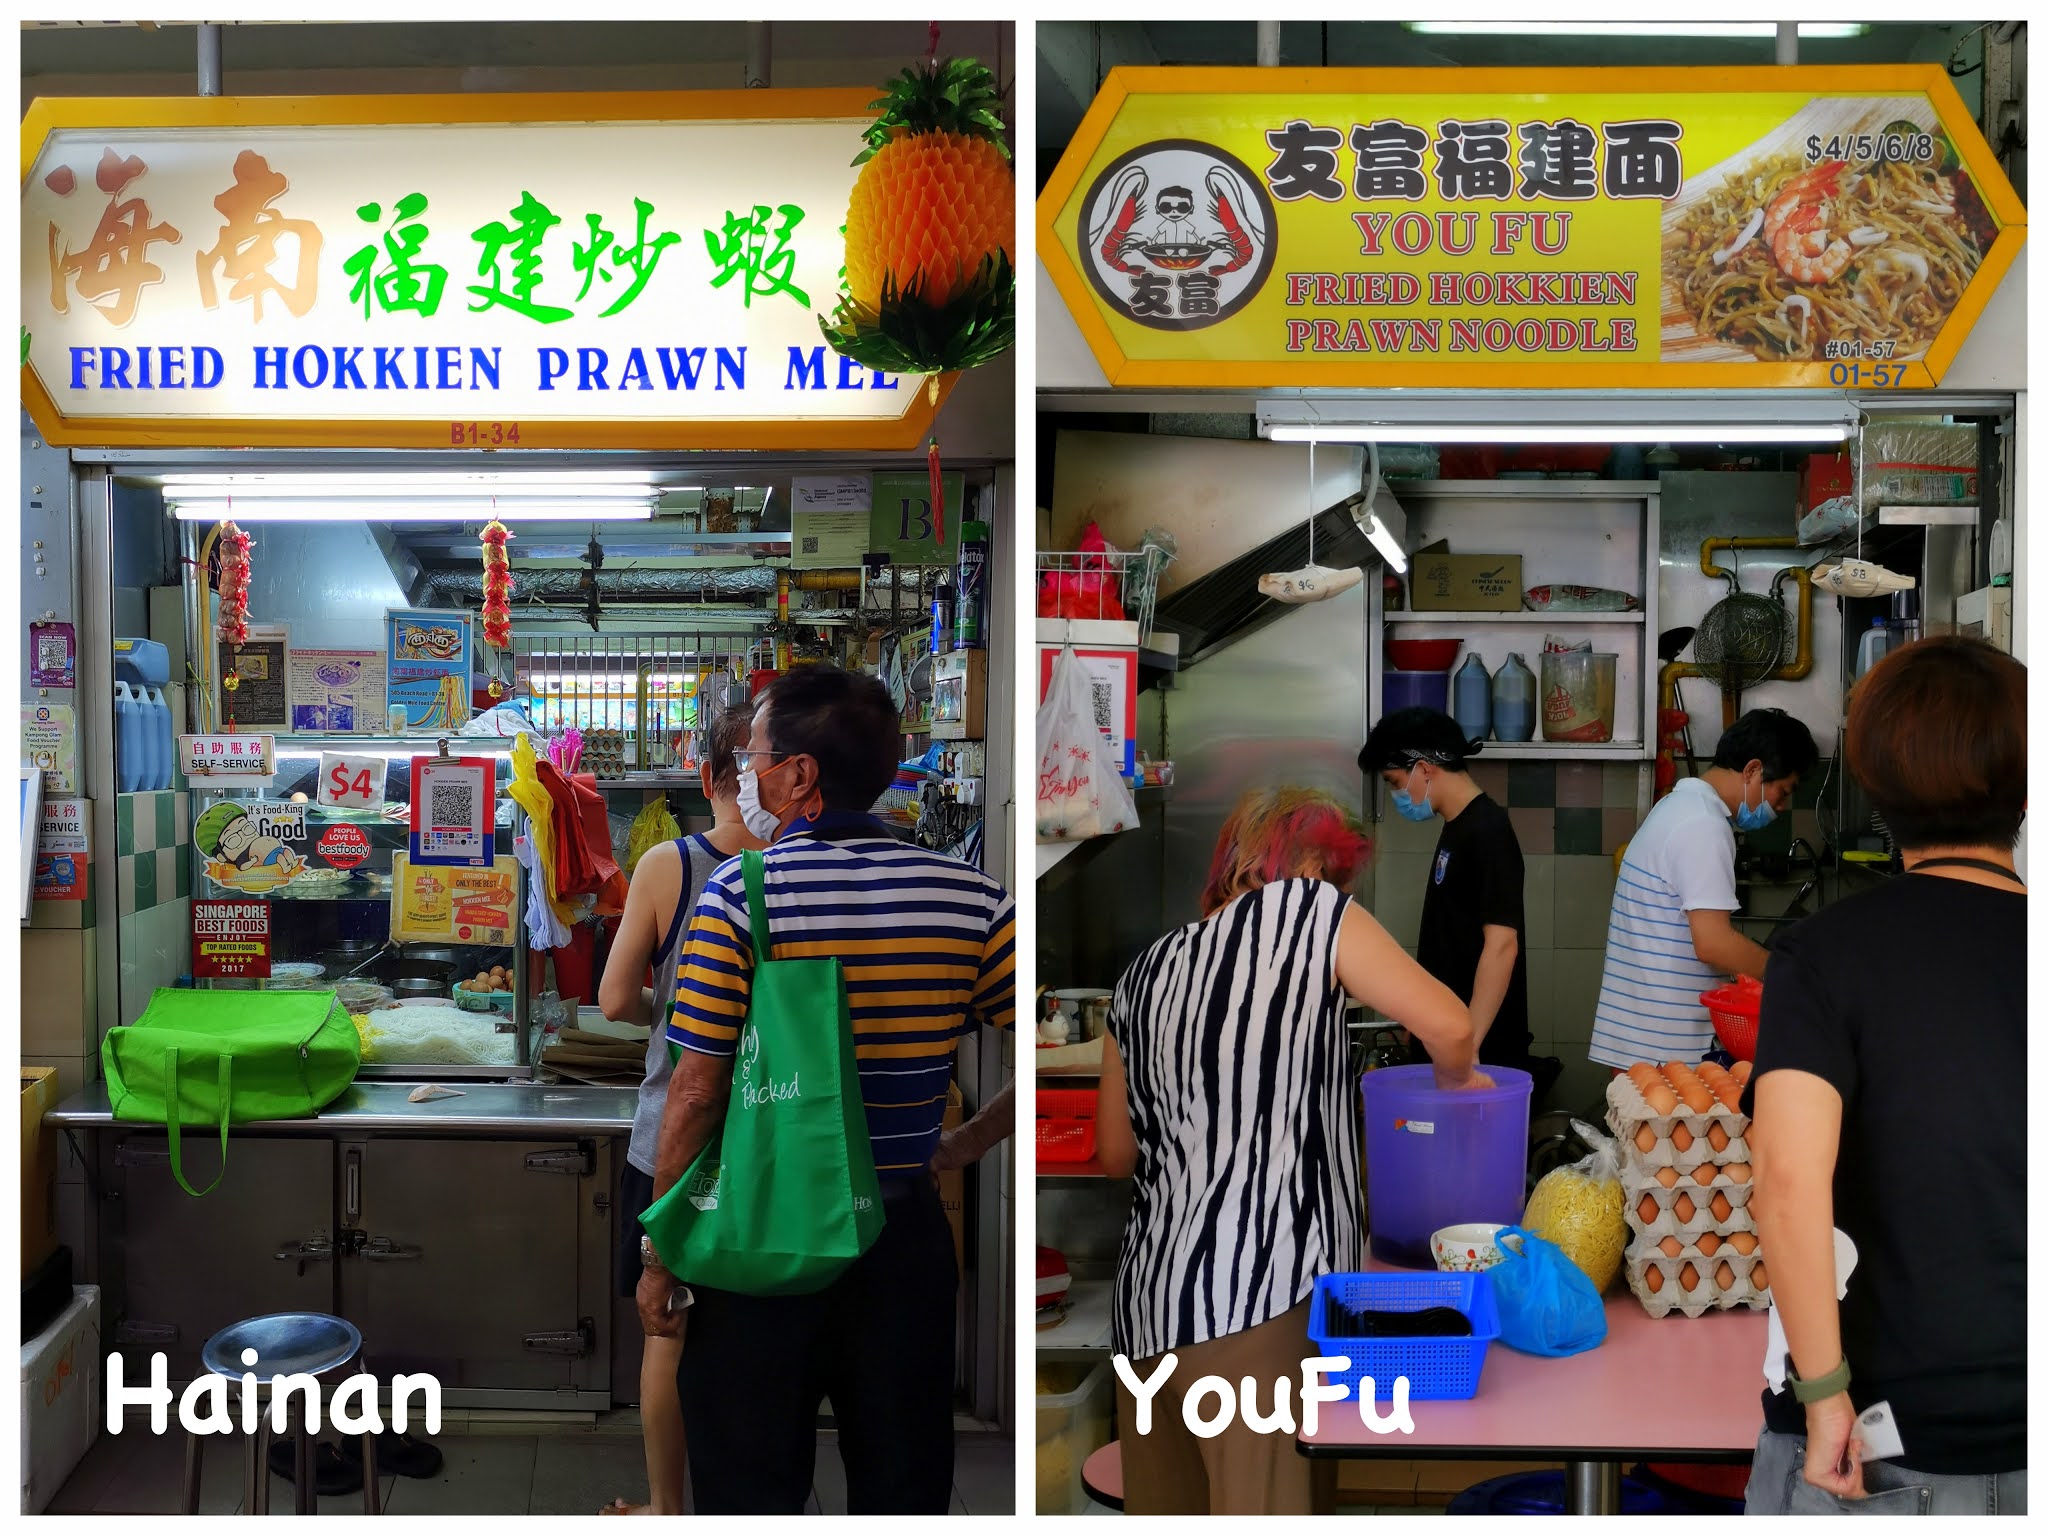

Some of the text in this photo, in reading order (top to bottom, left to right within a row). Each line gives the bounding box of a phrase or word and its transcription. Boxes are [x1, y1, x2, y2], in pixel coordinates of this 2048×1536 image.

[1265, 117, 1684, 202] 友富福建面
[1805, 133, 1934, 162] $4/5/6/8
[45, 146, 851, 329] 海南福建炒蝦
[1352, 210, 1573, 256] YOU FU
[1128, 271, 1222, 318] 友富
[1286, 271, 1638, 306] FRIED HOKKIEN
[1286, 318, 1638, 353] PRAWN NOODLE
[1825, 340, 1897, 358] #01-57
[68, 345, 225, 391] FRIED
[253, 344, 502, 391] HOKKIEN
[537, 346, 748, 391] PRAWN
[1829, 362, 1908, 387] 01-57
[451, 422, 520, 445] B1-34
[897, 498, 932, 541] B
[192, 741, 263, 756] 自助服務
[329, 762, 373, 801] $4
[247, 803, 304, 817] It's Food-King
[259, 817, 305, 839] Good
[319, 843, 370, 857] bestfoody
[455, 879, 471, 887] ONLY
[482, 880, 497, 888] BEST
[195, 904, 268, 919] SINGAPORE
[197, 920, 265, 932] BEST FOODS
[206, 943, 257, 951] TOP RATED FOODS
[221, 964, 245, 972] 2017
[741, 1071, 801, 1110] Packed
